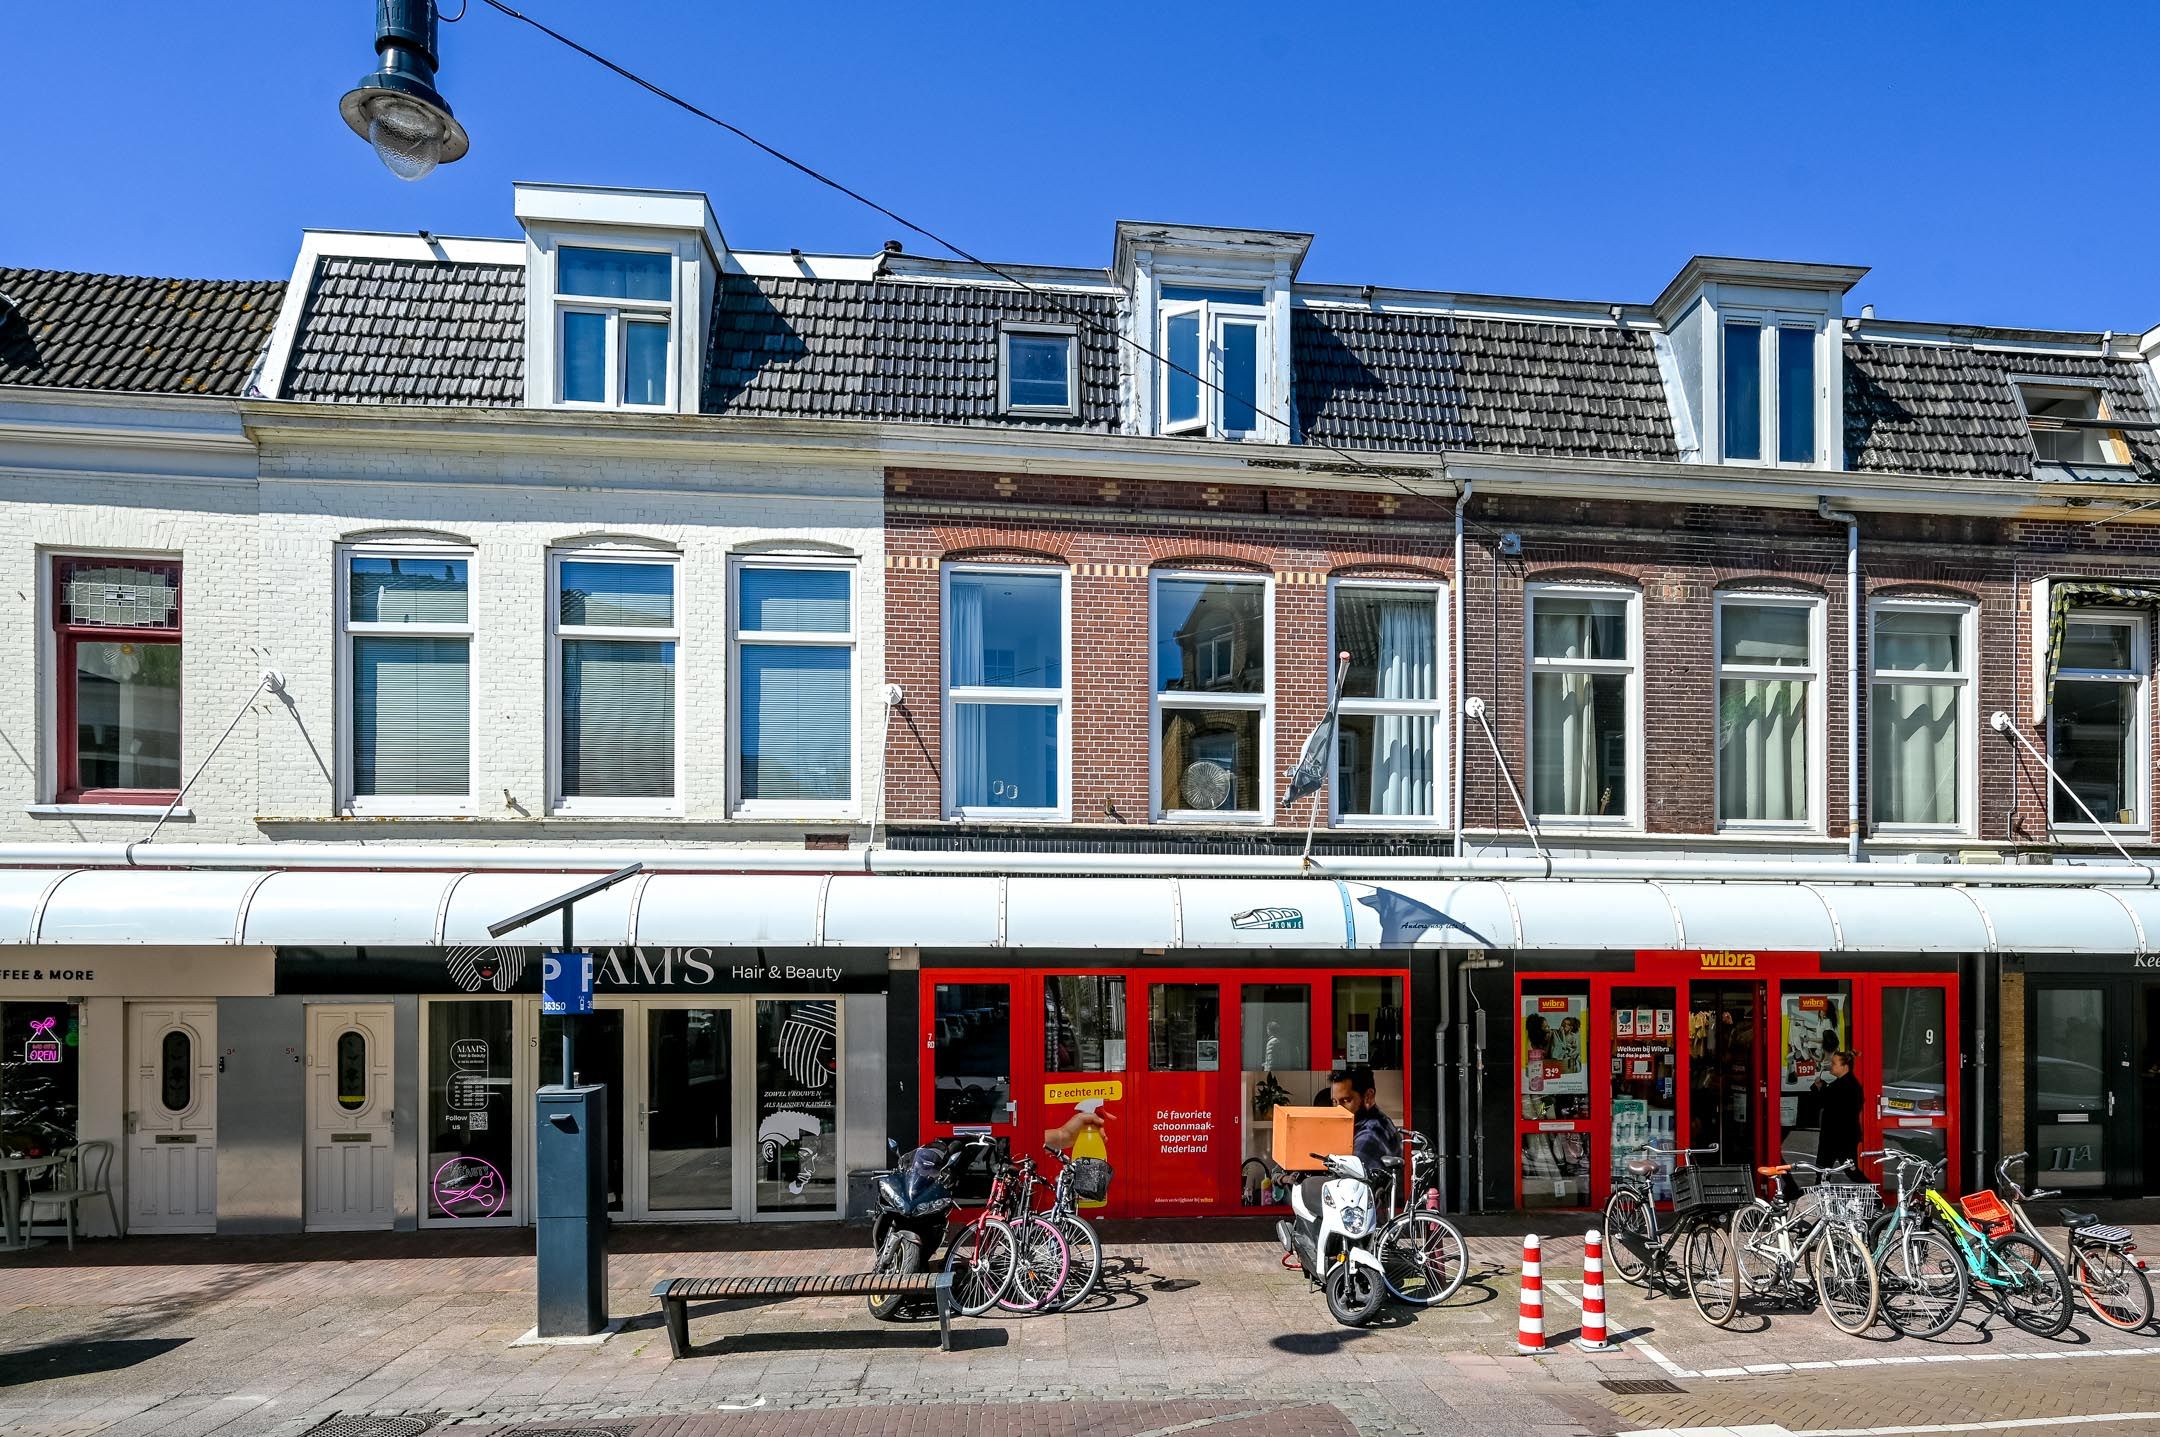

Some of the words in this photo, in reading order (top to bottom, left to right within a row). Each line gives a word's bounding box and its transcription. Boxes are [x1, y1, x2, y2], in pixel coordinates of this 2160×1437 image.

[1700, 951, 1756, 968] wibra
[551, 947, 715, 985] AM'S
[732, 965, 764, 979] Hair
[768, 965, 782, 979] &
[786, 965, 842, 982] Beauty
[33, 970, 43, 980] &
[49, 970, 94, 981] MORE
[543, 957, 562, 992] P
[1541, 999, 1565, 1008] wibra
[1802, 998, 1824, 1007] wibra
[530, 1037, 537, 1047] 5
[927, 1033, 933, 1041] 7
[1925, 1029, 1934, 1045] 9
[1642, 1045, 1651, 1053] bij
[30, 1050, 57, 1061] OPEN
[1545, 1068, 1559, 1077] 3.49
[1049, 1089, 1062, 1098] De
[1064, 1087, 1091, 1097] echte
[1094, 1087, 1107, 1096] nr.
[1109, 1086, 1114, 1095] 1
[1157, 1110, 1169, 1119] Dé
[1170, 1110, 1212, 1120] favoriete
[1153, 1122, 1215, 1131] schoonmaak-
[1159, 1133, 1191, 1143] topper
[1192, 1134, 1209, 1142] van
[1160, 1145, 1208, 1153] Nederland
[2050, 1145, 2093, 1171] 11A
